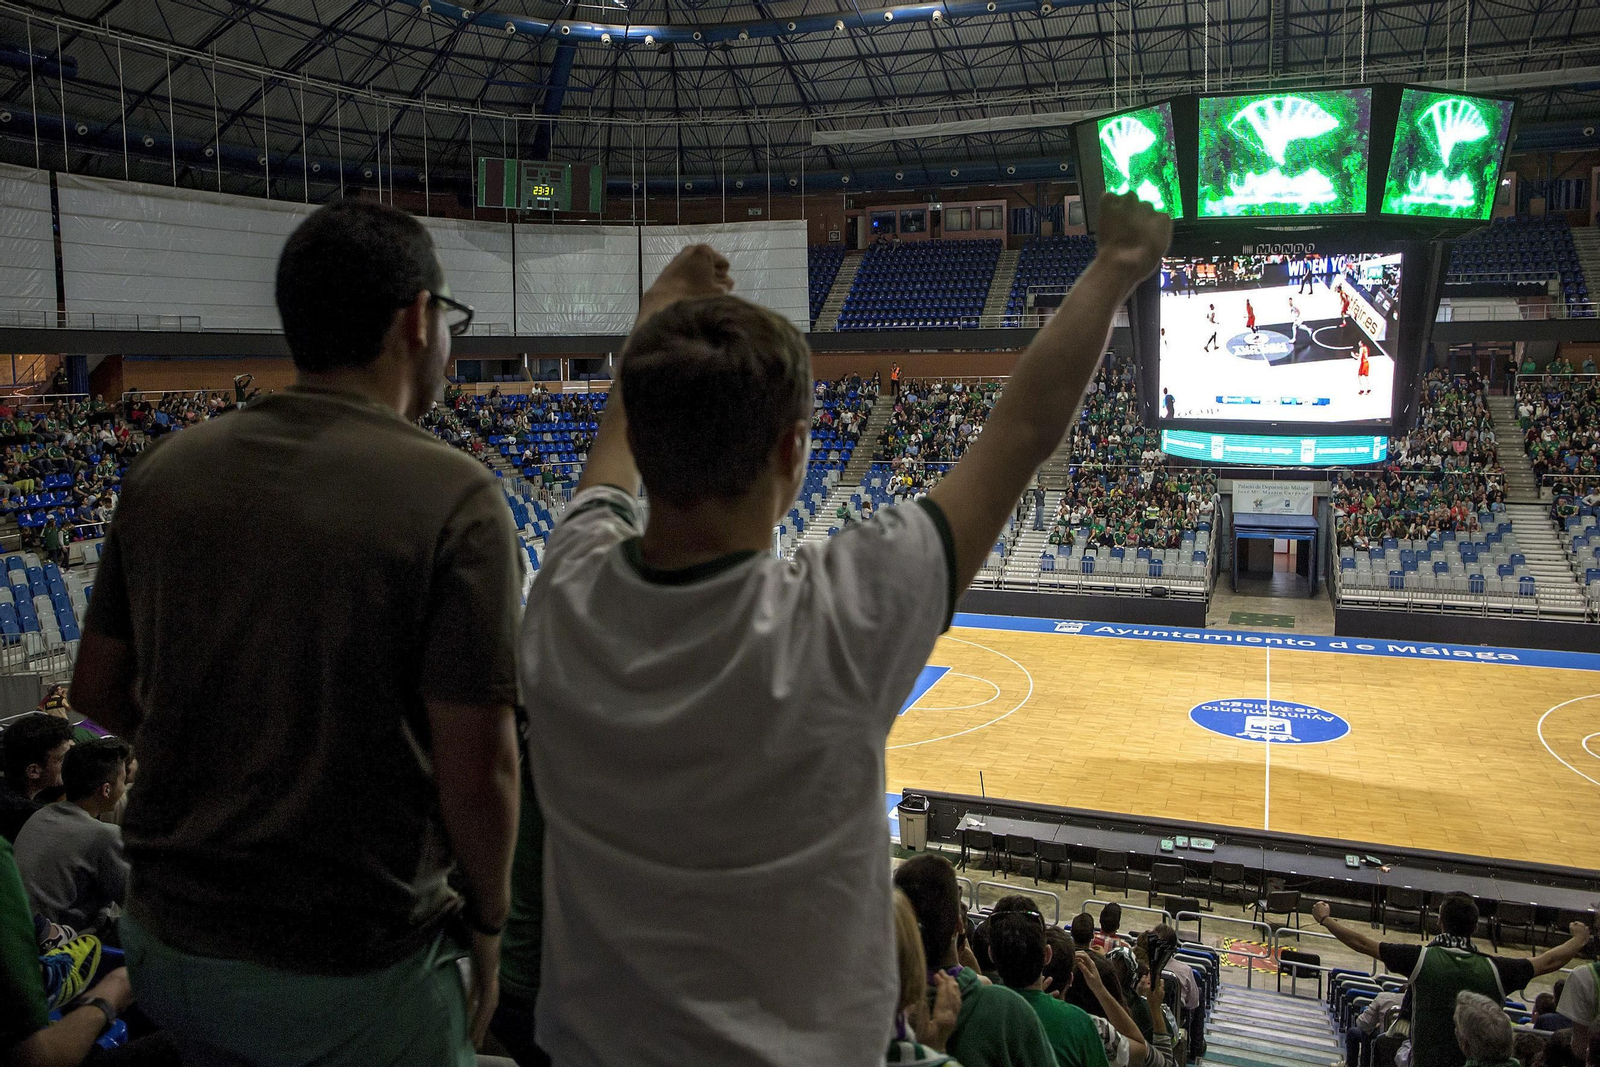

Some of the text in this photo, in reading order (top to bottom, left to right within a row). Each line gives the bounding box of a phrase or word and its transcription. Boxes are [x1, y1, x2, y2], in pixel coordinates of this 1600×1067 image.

[533, 186, 554, 196] 23:31
[1256, 242, 1316, 255] MONDO
[1094, 626, 1520, 661] Ayuntamiento de Málaga
[1201, 705, 1335, 723] Ayuntamiento
